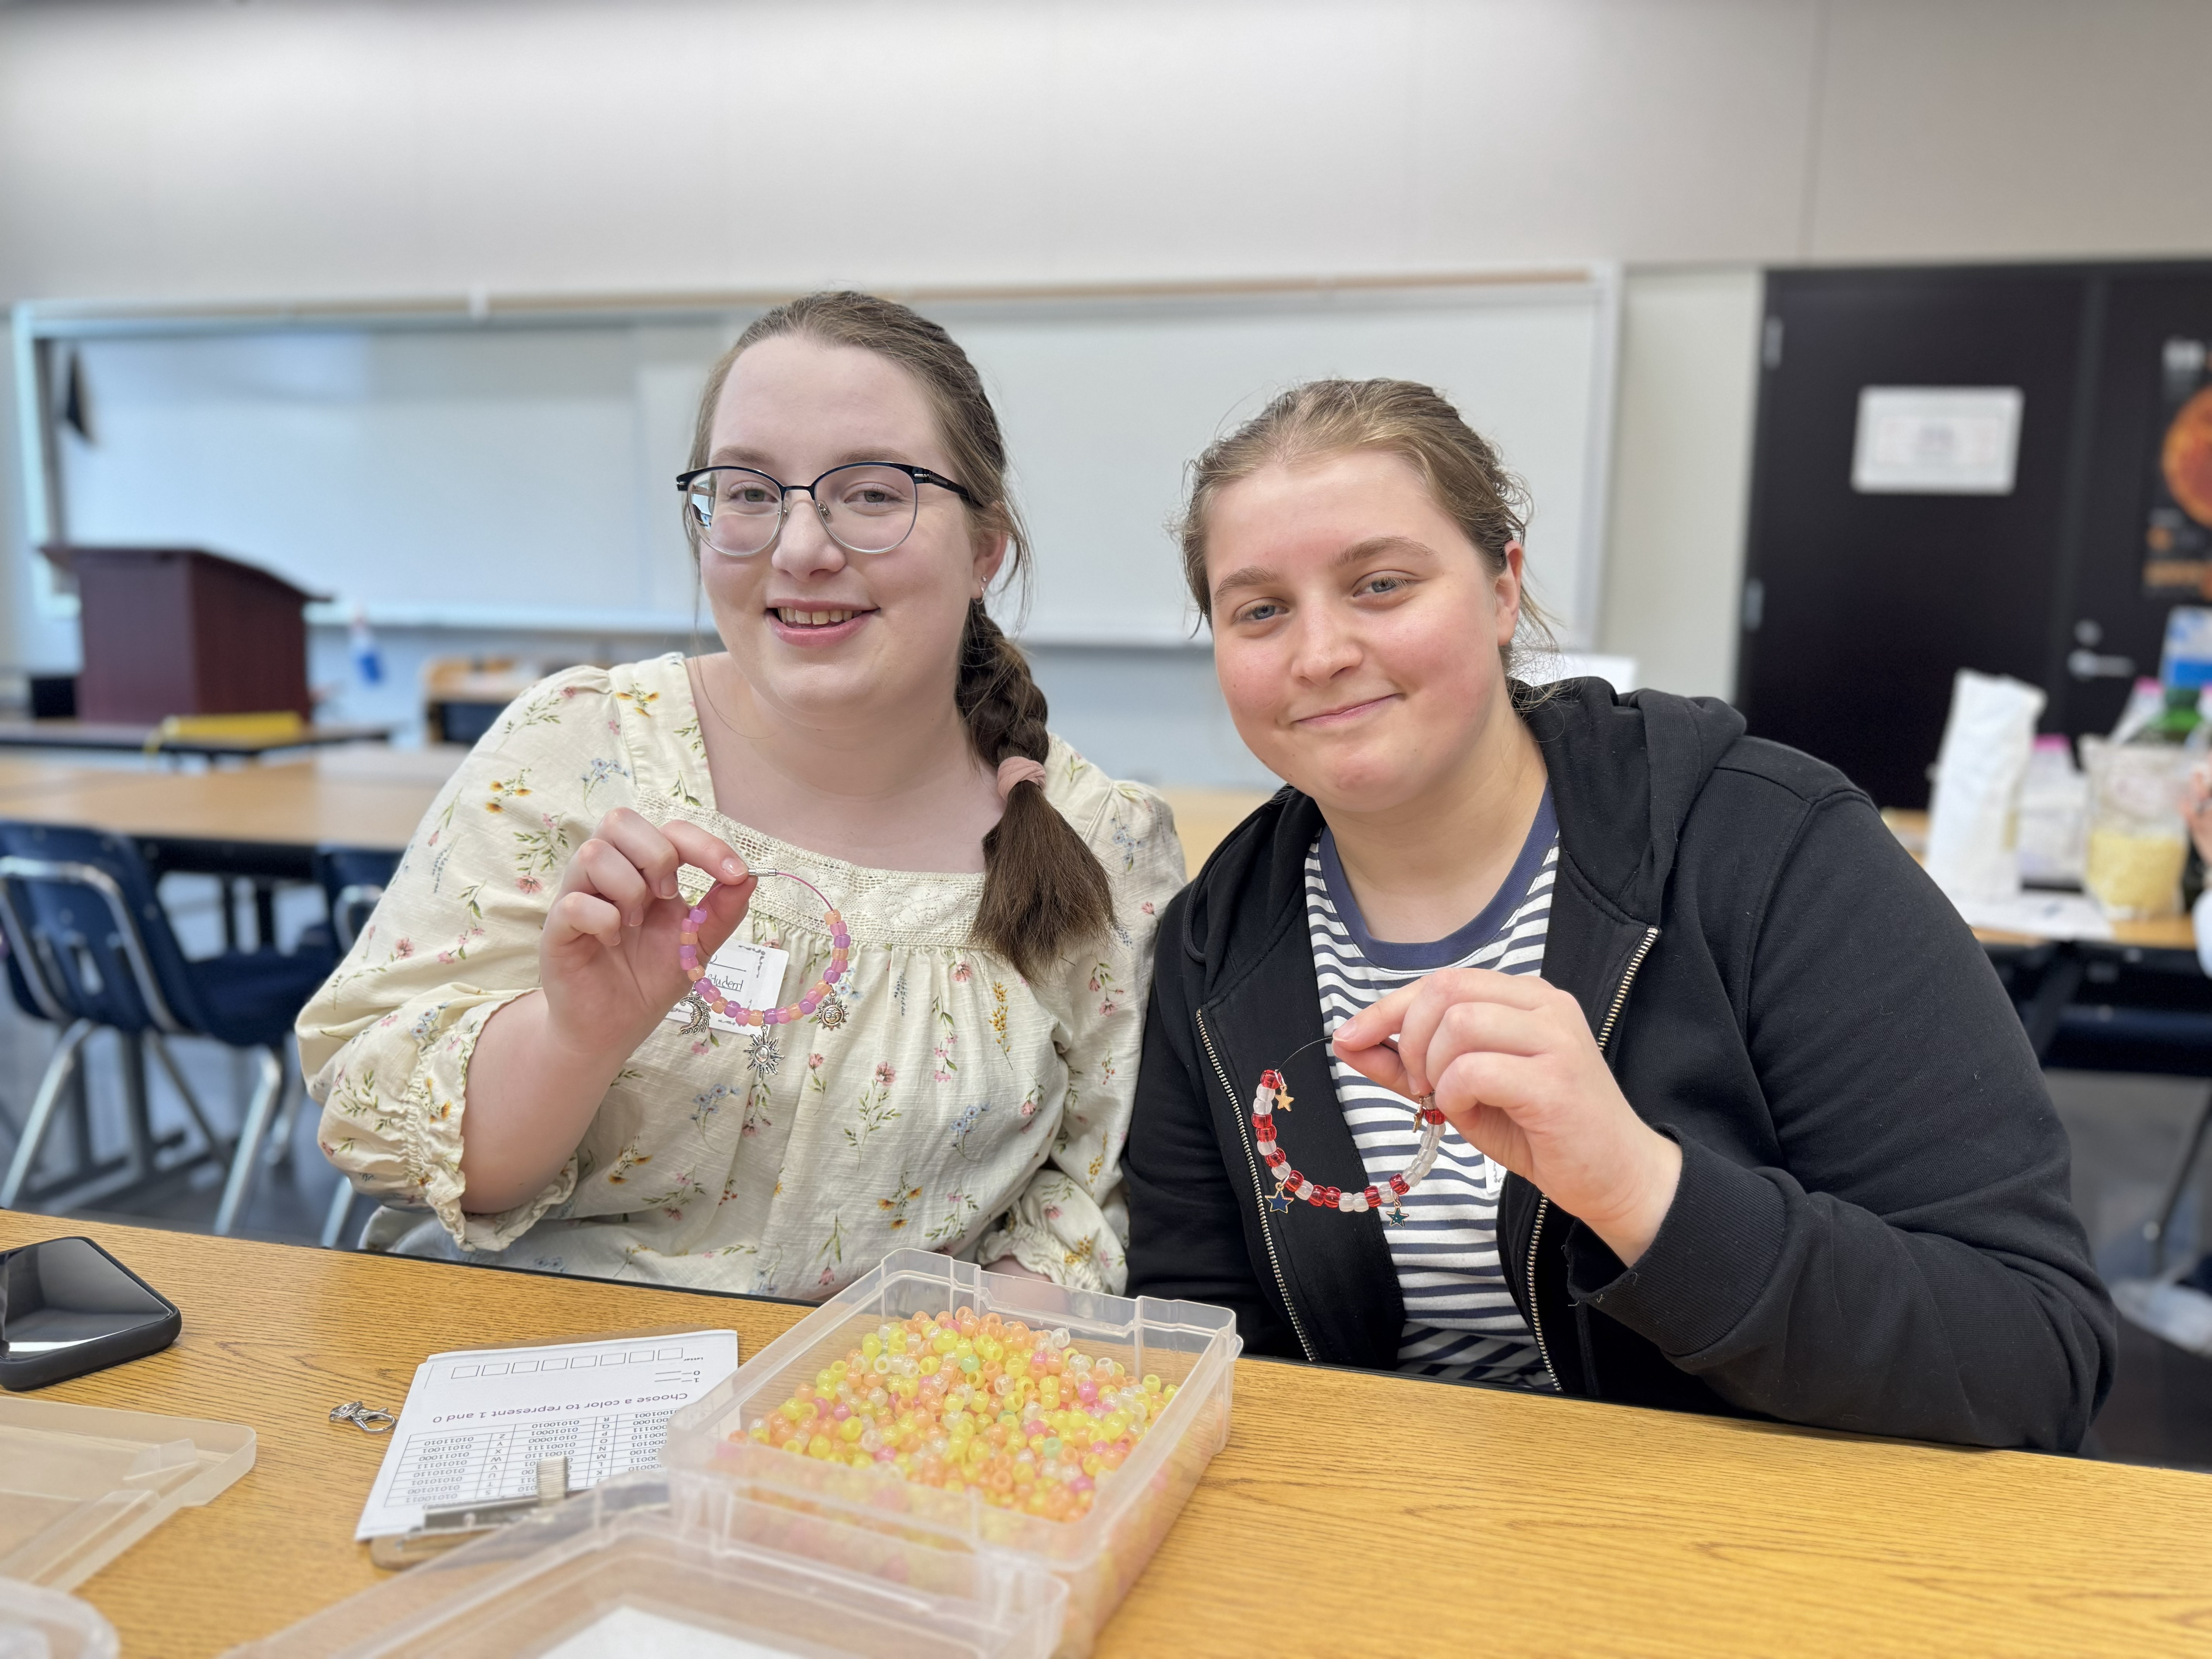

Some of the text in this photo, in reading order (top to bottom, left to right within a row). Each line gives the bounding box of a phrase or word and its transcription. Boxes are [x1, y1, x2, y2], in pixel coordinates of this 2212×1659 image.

[637, 1393, 687, 1403] Choose
[584, 1400, 619, 1408] color
[491, 1405, 561, 1417] represent
[447, 1413, 474, 1422] and
[532, 1420, 579, 1428] 01010010
[531, 1427, 578, 1436] 01010001
[424, 1437, 474, 1446] 01011010
[529, 1435, 577, 1443] 01010000
[423, 1444, 472, 1453] 01011001
[527, 1442, 575, 1451] 01001111
[419, 1452, 469, 1461] 01011000
[525, 1450, 574, 1459] 01001110
[417, 1460, 467, 1469] 01010111
[414, 1468, 465, 1477] 01010110
[411, 1477, 462, 1486] 01010101
[407, 1485, 460, 1494] 01010100
[406, 1494, 457, 1503] 01010011
